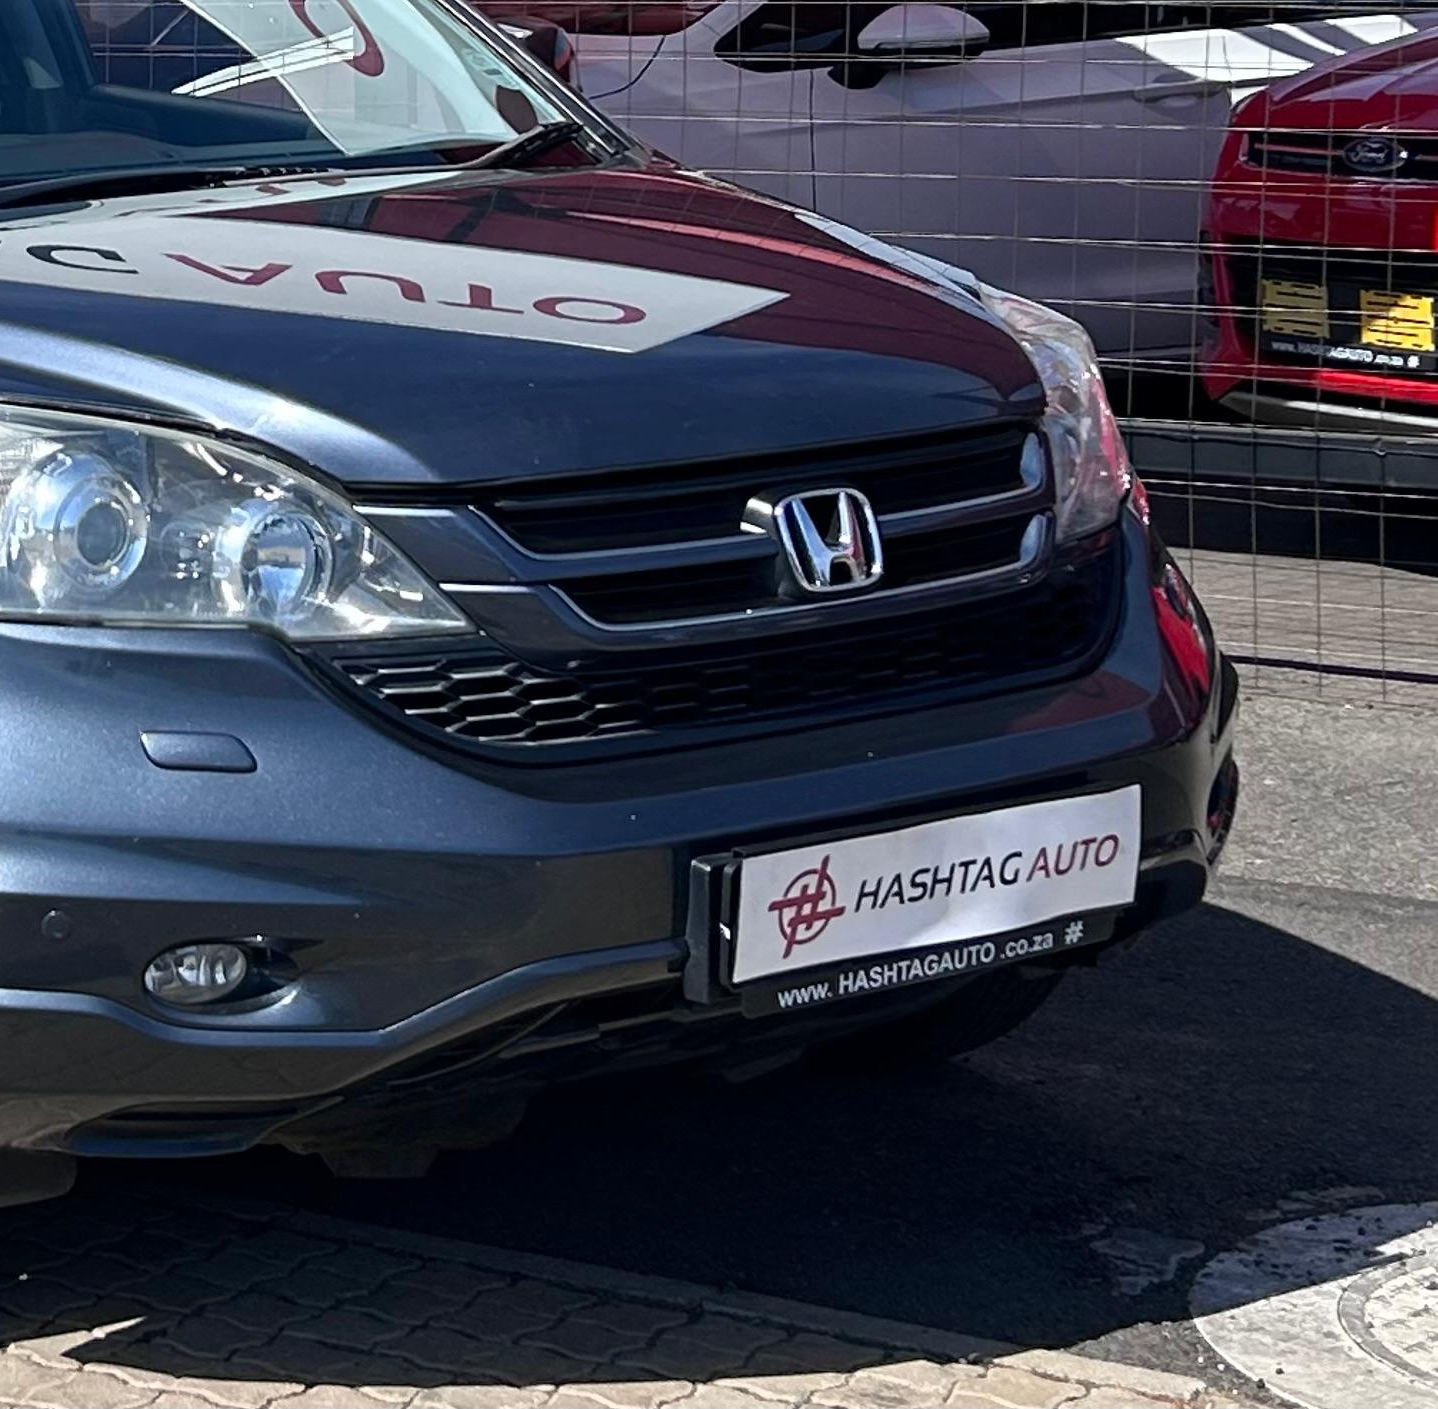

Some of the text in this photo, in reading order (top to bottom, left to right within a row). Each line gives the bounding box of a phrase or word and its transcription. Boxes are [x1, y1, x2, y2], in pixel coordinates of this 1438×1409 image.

[854, 833, 1120, 913] HASHTAG AUTO
[838, 941, 995, 995] HASHTAGAUTO
